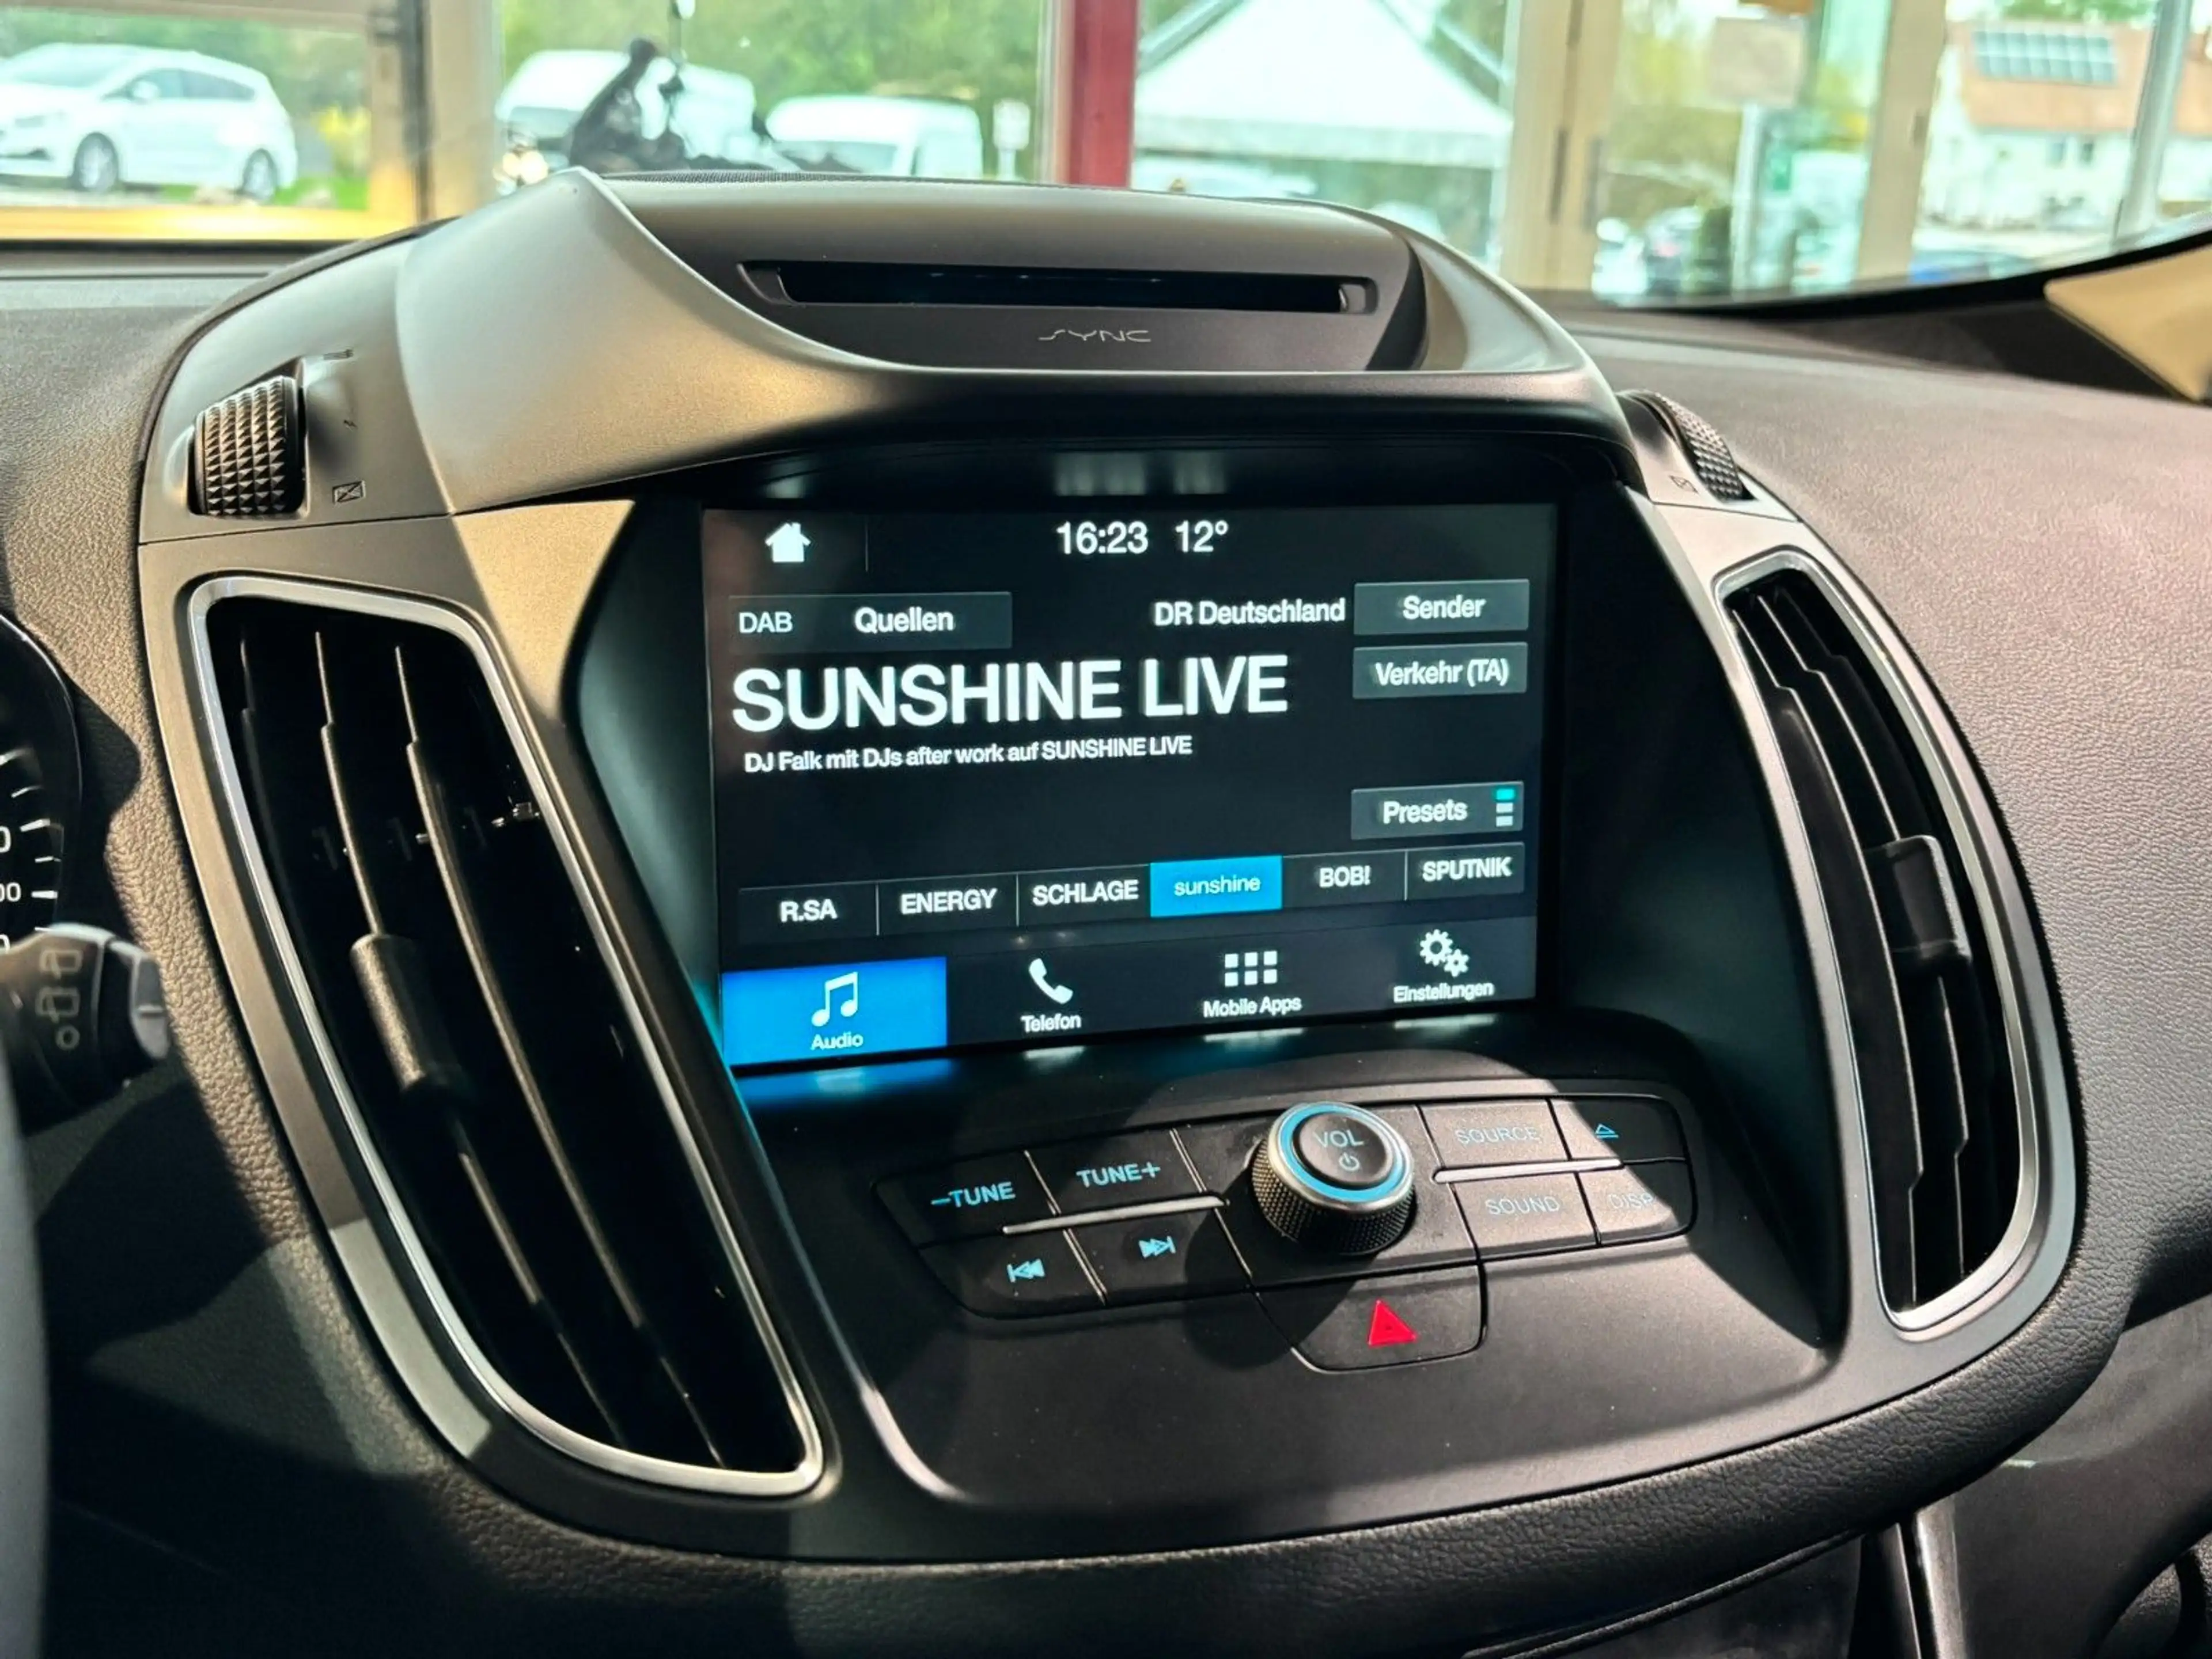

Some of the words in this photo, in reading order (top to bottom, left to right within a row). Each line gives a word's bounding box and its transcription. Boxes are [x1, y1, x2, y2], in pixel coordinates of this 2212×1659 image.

[1039, 329, 1152, 343] SYNC
[1056, 521, 1149, 555] 16:23
[1175, 520, 1229, 552] 12°
[1154, 601, 1193, 626] DR
[1198, 597, 1346, 626] Deutschland
[1402, 594, 1486, 620] Sender
[738, 611, 793, 634] DAB
[854, 606, 955, 634] Quellen
[1374, 660, 1464, 686] Verkehr
[1467, 658, 1510, 687] (TA)
[732, 659, 1123, 733] SUNSHINE
[1144, 654, 1288, 717] LIVE
[744, 752, 774, 773] DJ
[778, 750, 823, 771] Falk
[825, 749, 859, 770] mit
[863, 748, 903, 768] DJs
[906, 746, 952, 766] after
[955, 744, 1005, 764] work
[1007, 742, 1039, 762] auf
[1041, 737, 1147, 760] SUNSHINE
[1149, 735, 1193, 756] LIVE
[1383, 799, 1468, 824] Presets
[1319, 865, 1371, 888] BOB!
[1422, 857, 1513, 882] SPUTNIK
[1032, 879, 1139, 906] SCHLAGE
[1174, 874, 1262, 896] sunshine
[780, 899, 838, 922] R.SA
[900, 888, 998, 915] ENERGY
[1393, 982, 1495, 1003] Einstellungen
[1203, 999, 1257, 1018] Mobile
[1260, 996, 1302, 1016] Apps
[1021, 1013, 1082, 1033] Telefon
[810, 1031, 863, 1050] Audio
[1315, 1128, 1365, 1148] VOL
[1455, 1126, 1540, 1145] SOURCE
[1484, 1195, 1560, 1215] SOUND
